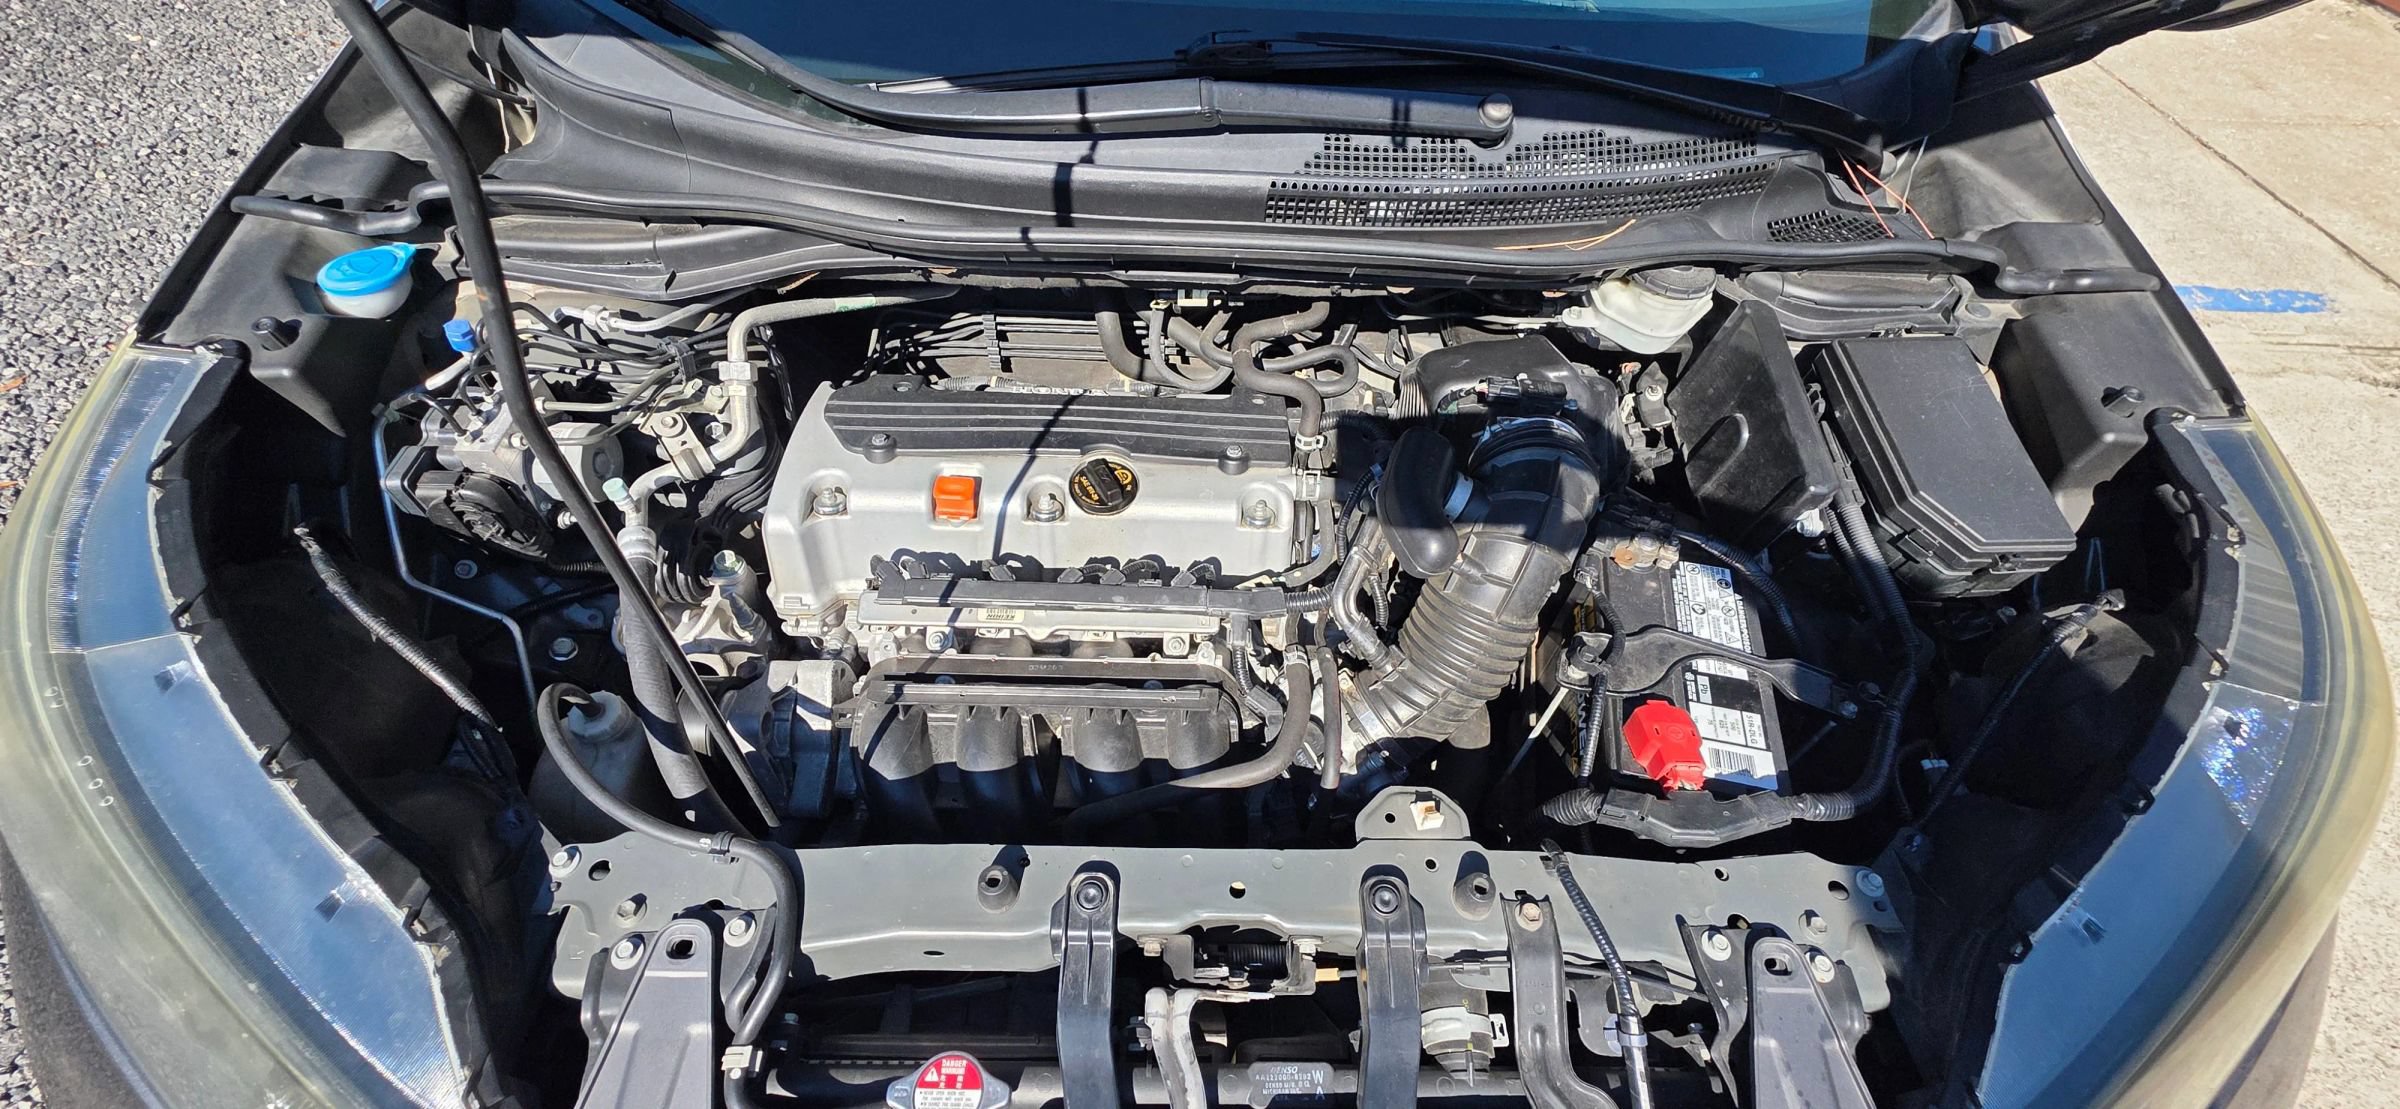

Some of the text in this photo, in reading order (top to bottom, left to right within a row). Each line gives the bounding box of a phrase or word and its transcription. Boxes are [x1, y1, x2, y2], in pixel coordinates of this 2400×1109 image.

[1080, 476, 1091, 488] SAE
[1699, 683, 1709, 695] Pb
[942, 1059, 967, 1067] DANGER
[1271, 1066, 1298, 1074] DENSO
[1311, 1069, 1324, 1084] W
